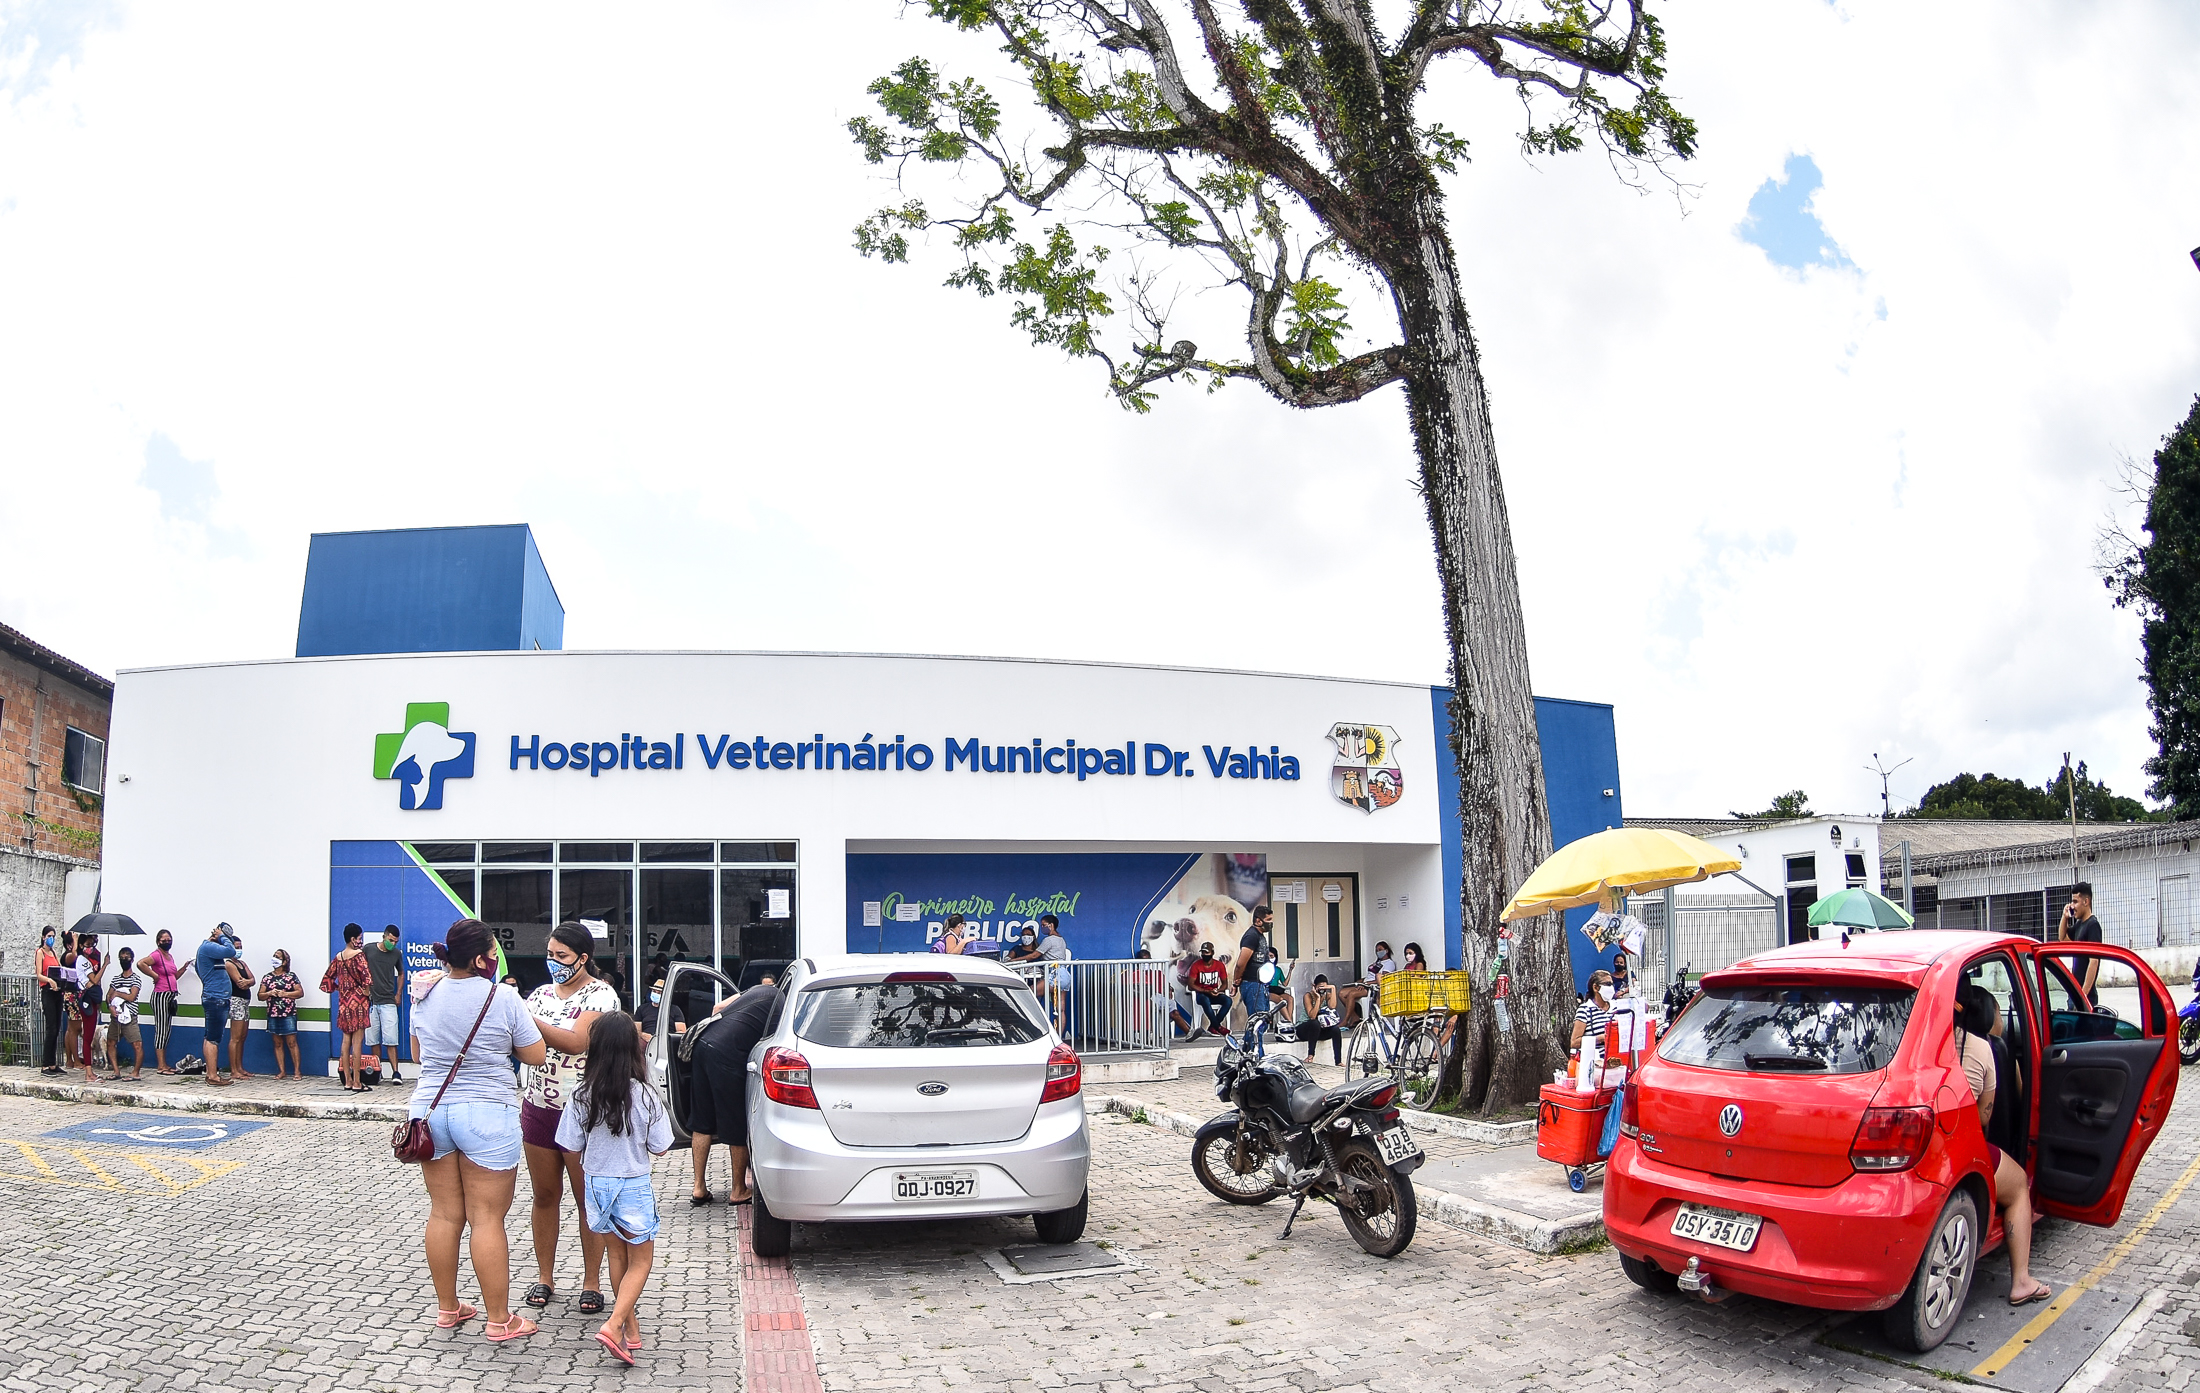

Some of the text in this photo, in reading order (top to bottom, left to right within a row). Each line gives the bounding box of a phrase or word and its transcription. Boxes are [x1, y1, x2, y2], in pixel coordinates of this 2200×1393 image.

[510, 733, 1301, 781] Hospital Veterinário Municipal Dr. Vahia
[1004, 891, 1081, 921] hospital
[925, 919, 1040, 945] PBLICO
[407, 942, 435, 956] Hosp
[923, 1084, 942, 1094] Ford
[1382, 1130, 1411, 1150] QDB
[1387, 1141, 1417, 1161] 4643
